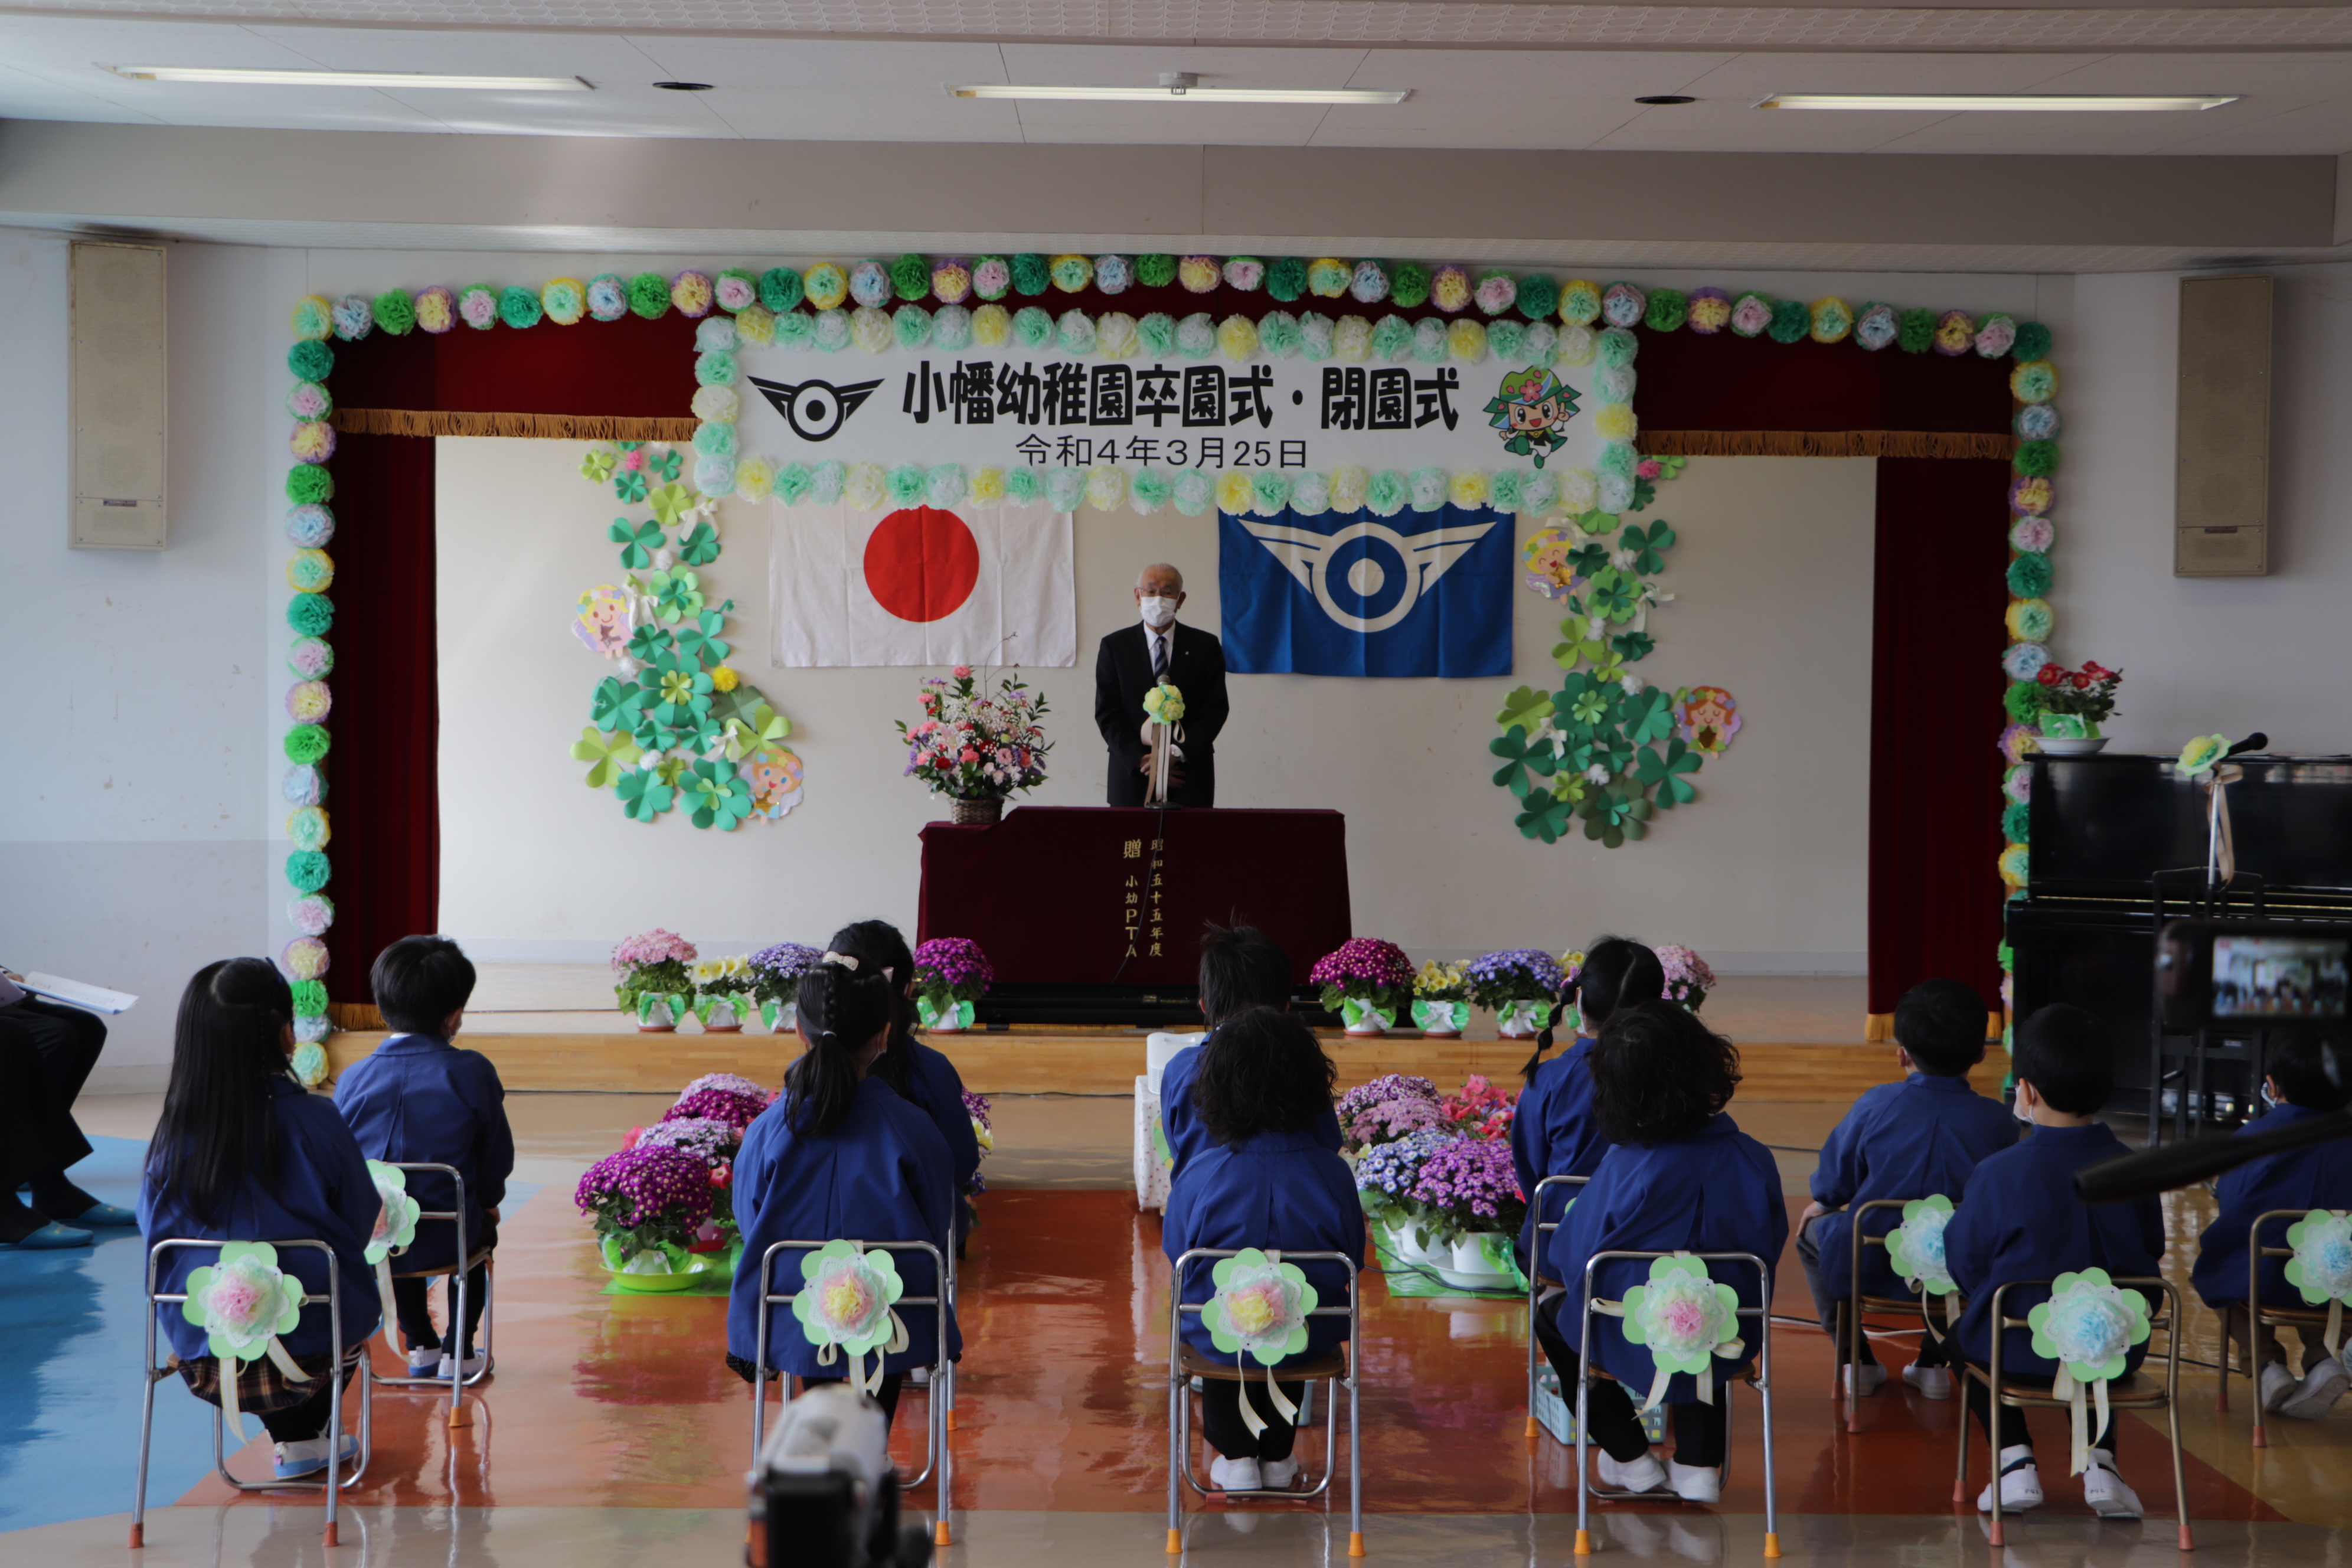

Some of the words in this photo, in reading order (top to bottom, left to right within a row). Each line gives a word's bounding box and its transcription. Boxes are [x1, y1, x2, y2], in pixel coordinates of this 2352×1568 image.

[903, 360, 1460, 432] 小幡幼稚園卒園式・閉園式
[1015, 433, 1306, 469] 令和4年3月25日
[1123, 838, 1142, 858] 贈
[1125, 875, 1139, 957] 小幼PTA
[1149, 838, 1164, 956] 昭和五十五年度
